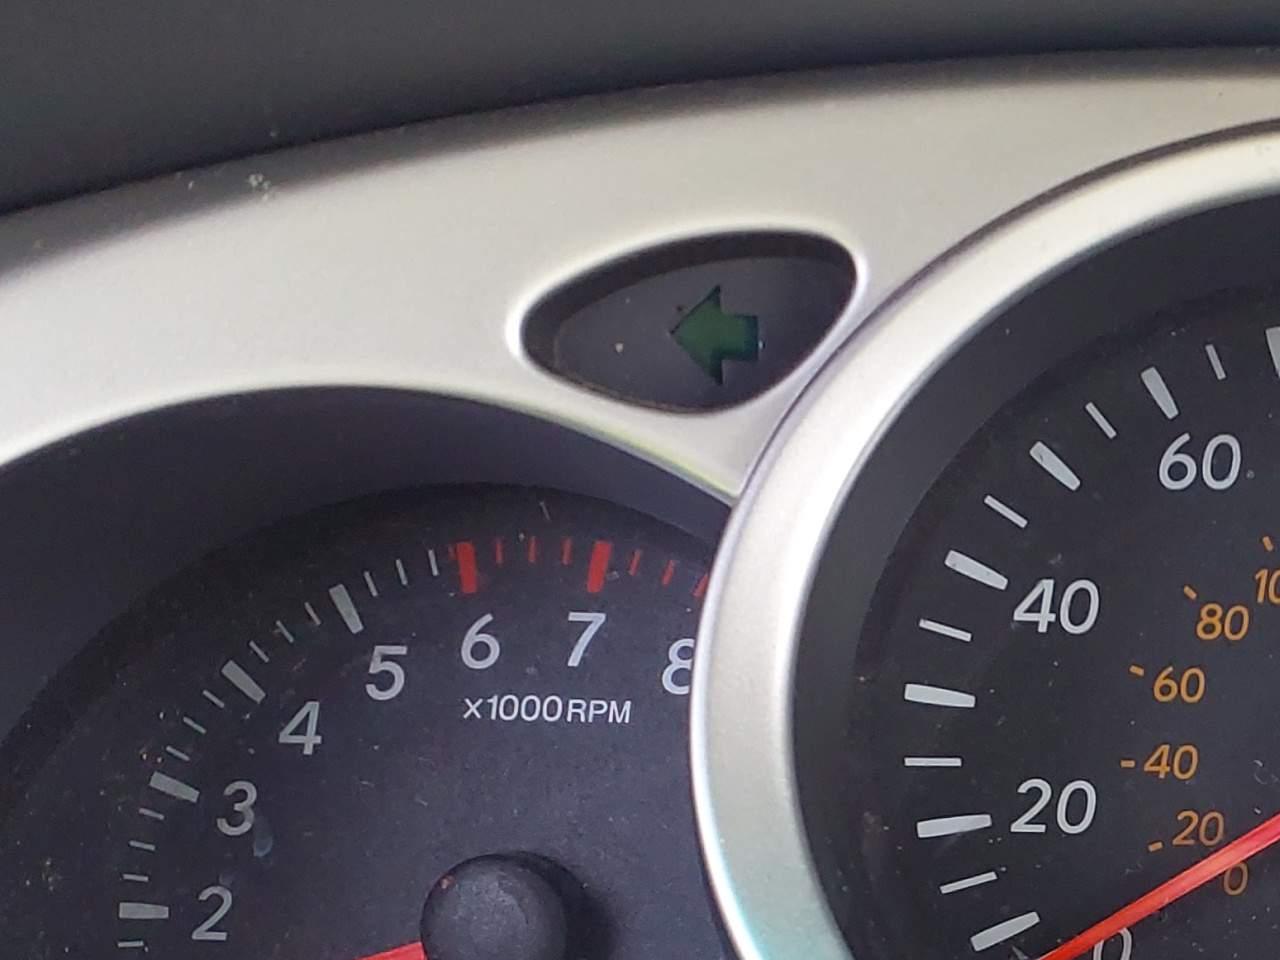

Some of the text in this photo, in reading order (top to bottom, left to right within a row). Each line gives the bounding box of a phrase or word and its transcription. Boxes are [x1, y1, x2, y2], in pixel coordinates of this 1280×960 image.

[1160, 434, 1240, 489] 60
[1014, 580, 1099, 633] 40
[1197, 604, 1248, 640] 80
[461, 614, 500, 669] 6
[568, 612, 606, 666] 7
[366, 646, 407, 700] 5
[662, 639, 694, 694] 8
[1154, 667, 1204, 702] 60
[279, 702, 321, 755] 4
[1144, 745, 1197, 779] 40
[218, 781, 257, 835] 3
[1011, 779, 1096, 833] 20
[1172, 811, 1224, 846] 20
[1223, 862, 1248, 895] 0
[192, 886, 232, 940] 2
